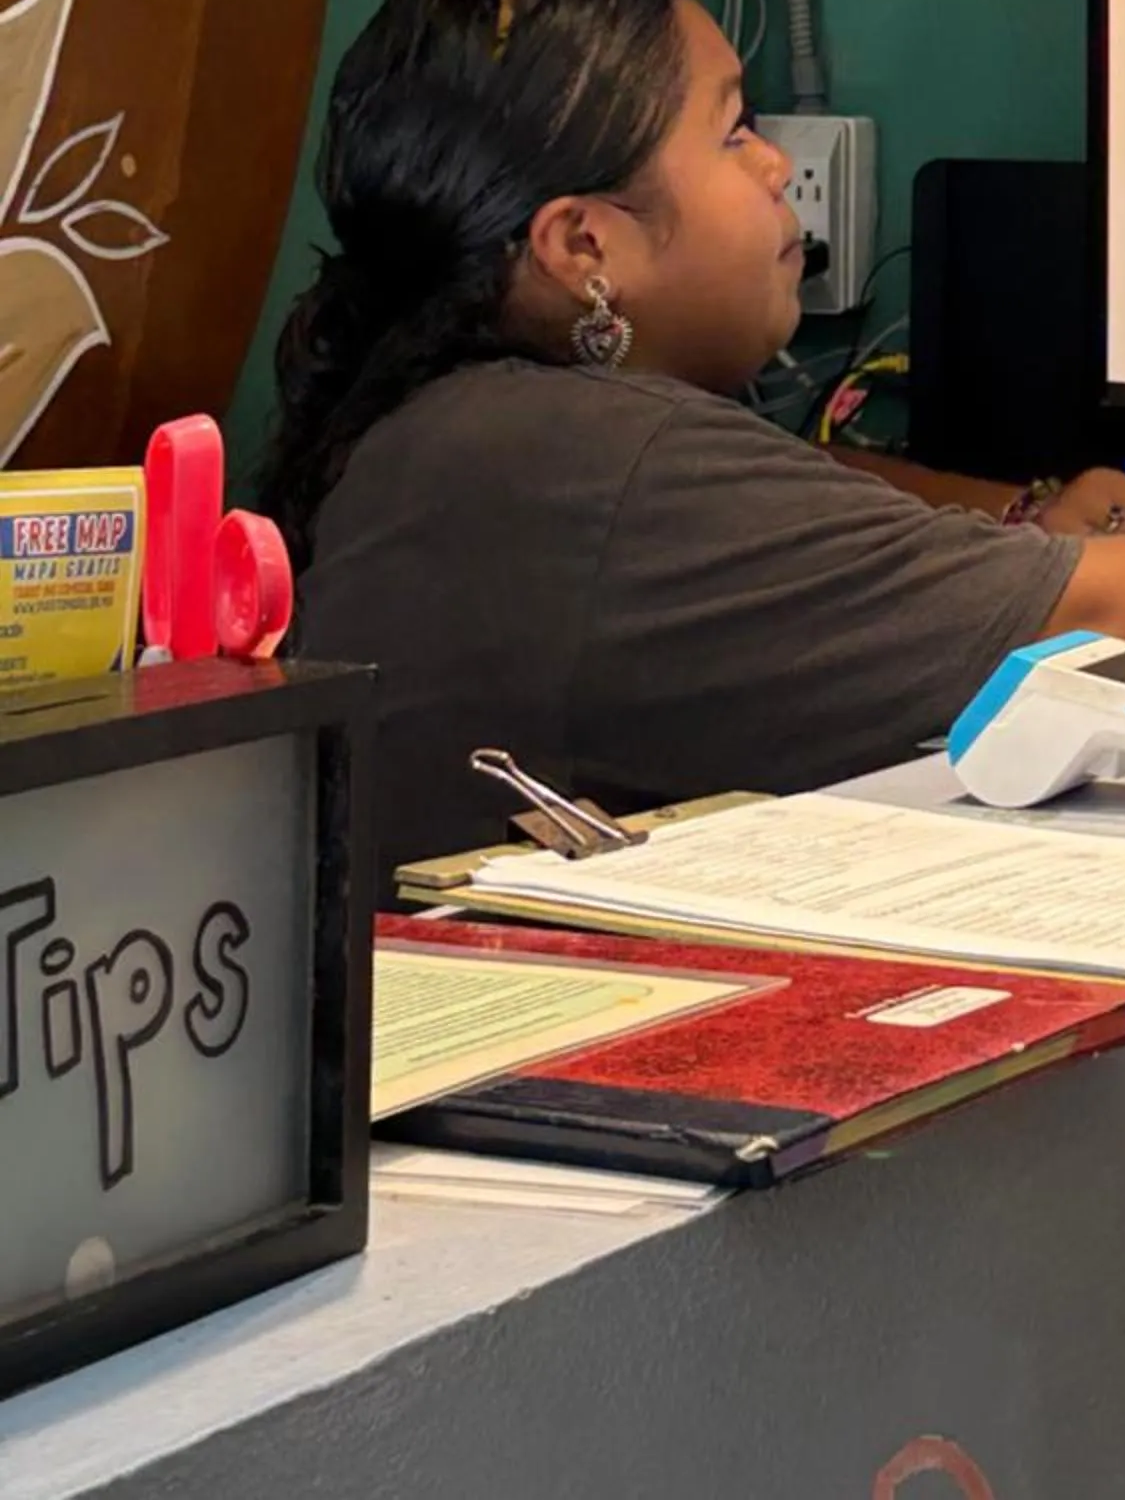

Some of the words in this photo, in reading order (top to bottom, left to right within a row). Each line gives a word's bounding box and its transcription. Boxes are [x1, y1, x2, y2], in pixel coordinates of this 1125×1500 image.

[14, 516, 69, 556] FREE
[75, 512, 126, 552] MAP
[14, 560, 57, 580] MAPA
[66, 556, 121, 578] GRATIS
